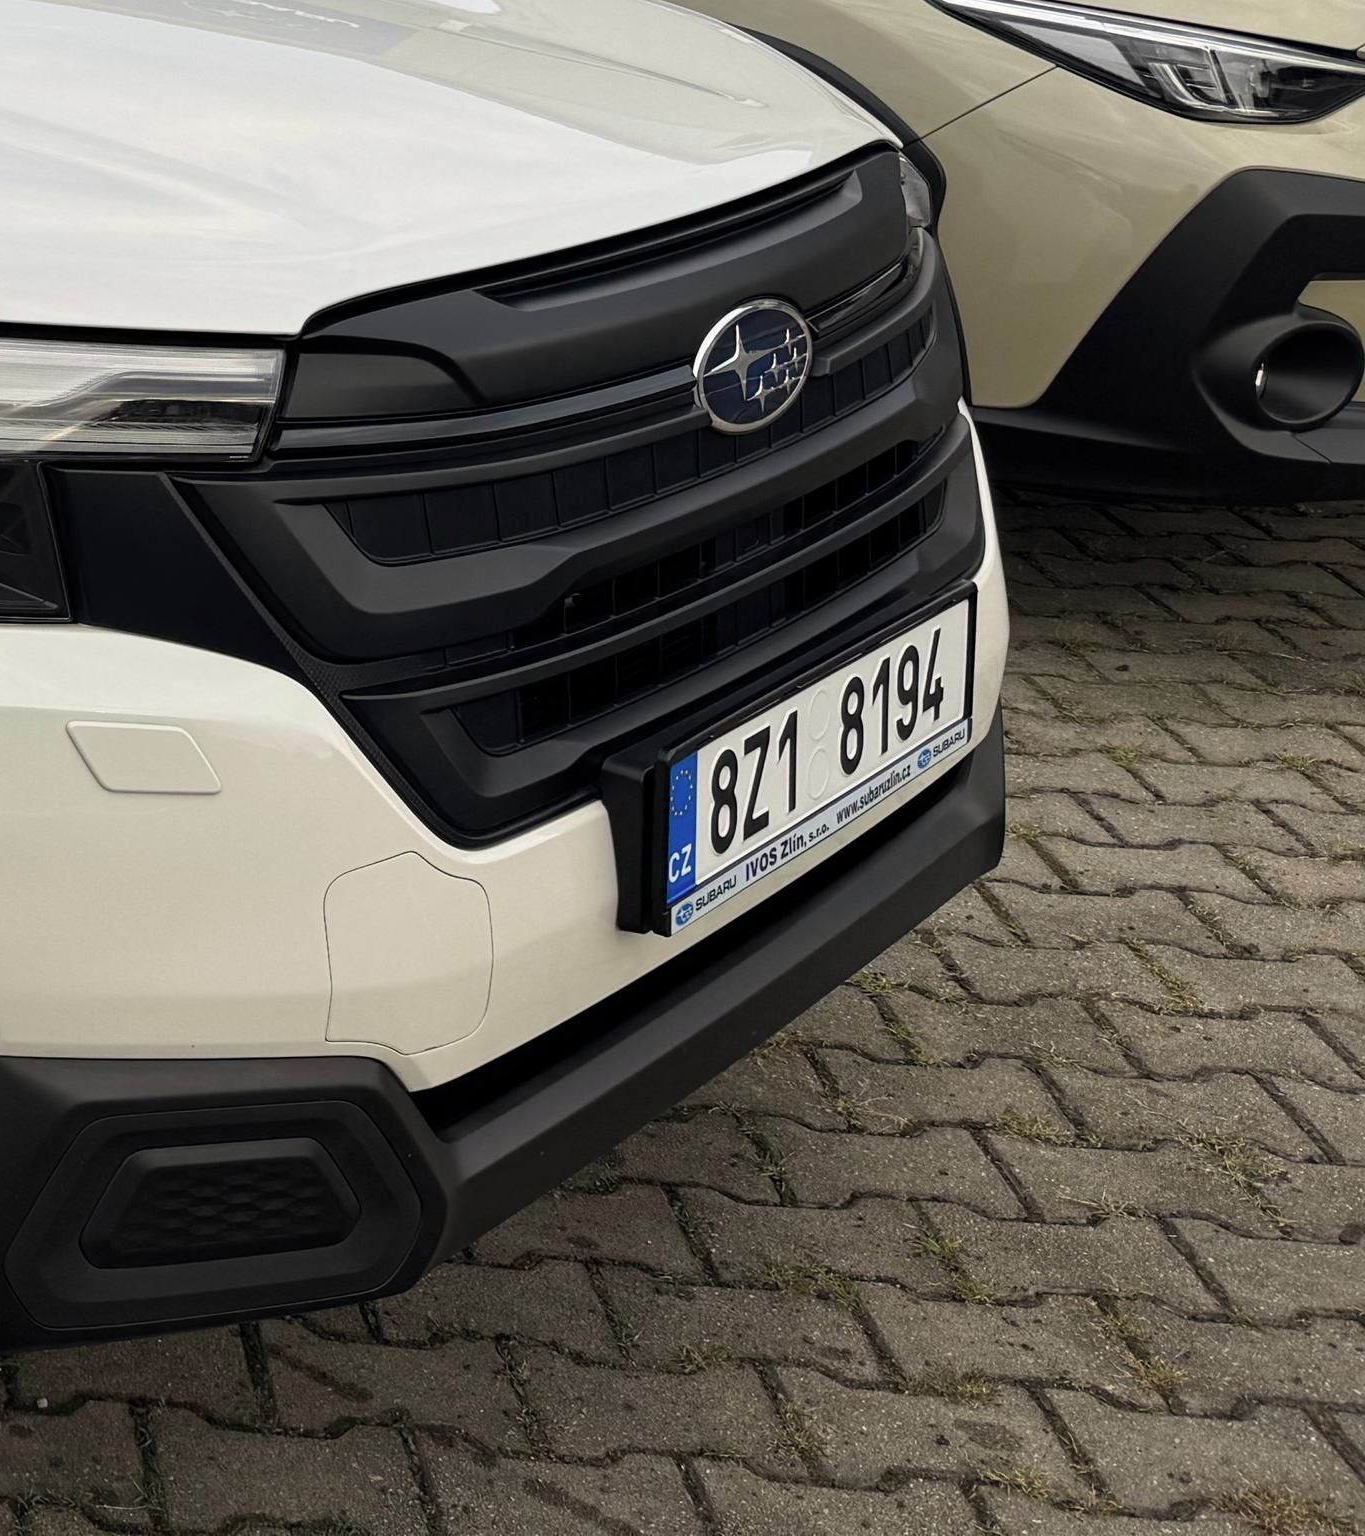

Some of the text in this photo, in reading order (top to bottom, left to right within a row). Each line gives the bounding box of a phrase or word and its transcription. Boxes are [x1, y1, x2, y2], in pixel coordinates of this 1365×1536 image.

[695, 875, 737, 911] SUBARU
[745, 847, 777, 882] IVOS
[780, 832, 807, 860] Zlín,
[808, 822, 830, 843] s.r.o.
[933, 728, 966, 758] SUBARU
[710, 628, 945, 855] 8Z1 8194
[668, 843, 692, 883] CZ
